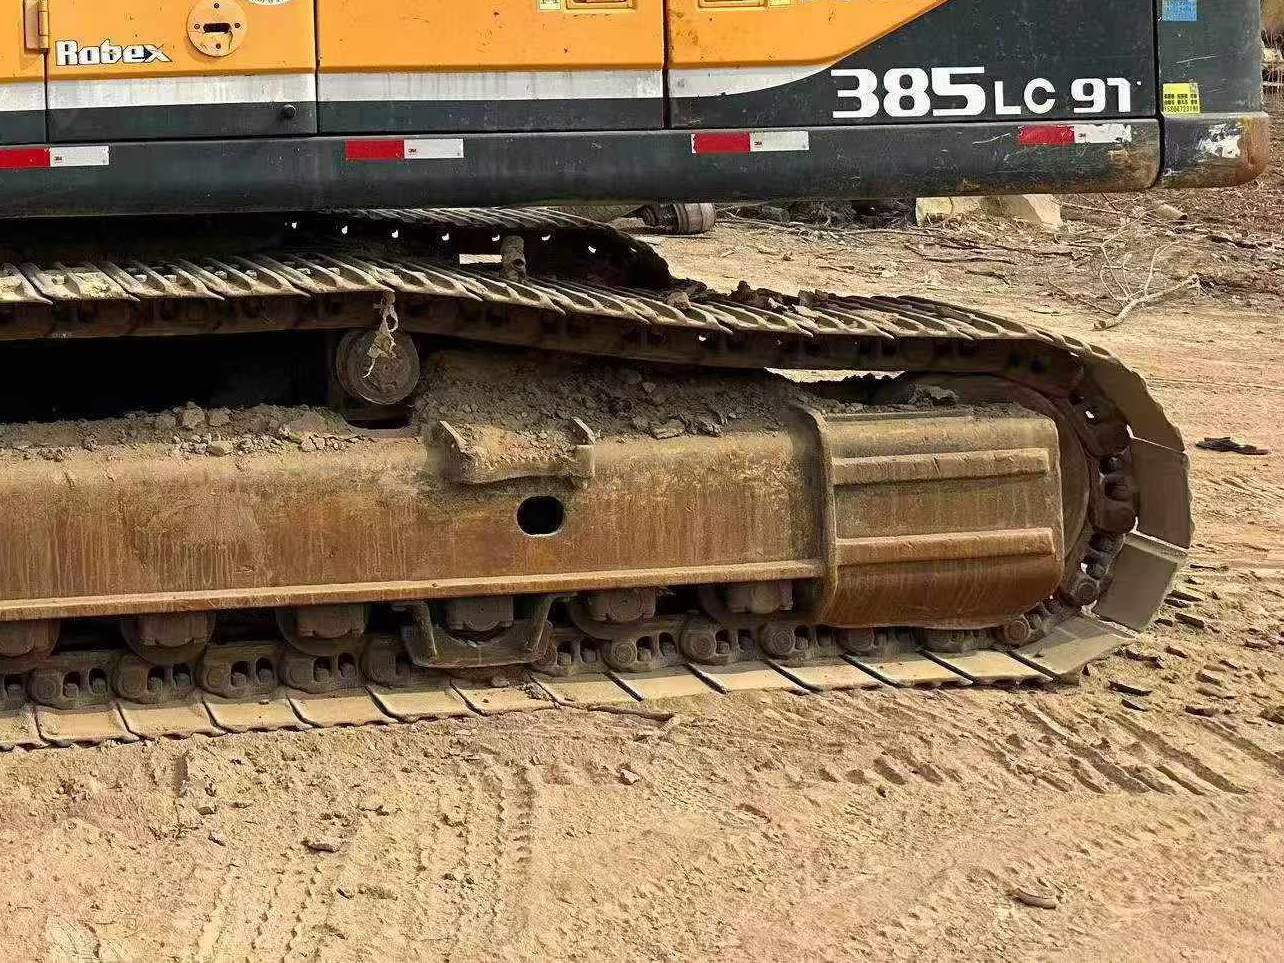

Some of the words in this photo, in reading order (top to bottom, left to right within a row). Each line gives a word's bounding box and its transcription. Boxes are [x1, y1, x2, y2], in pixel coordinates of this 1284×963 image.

[54, 38, 173, 66] Robex
[830, 66, 986, 119] 385
[994, 77, 1056, 115] LC
